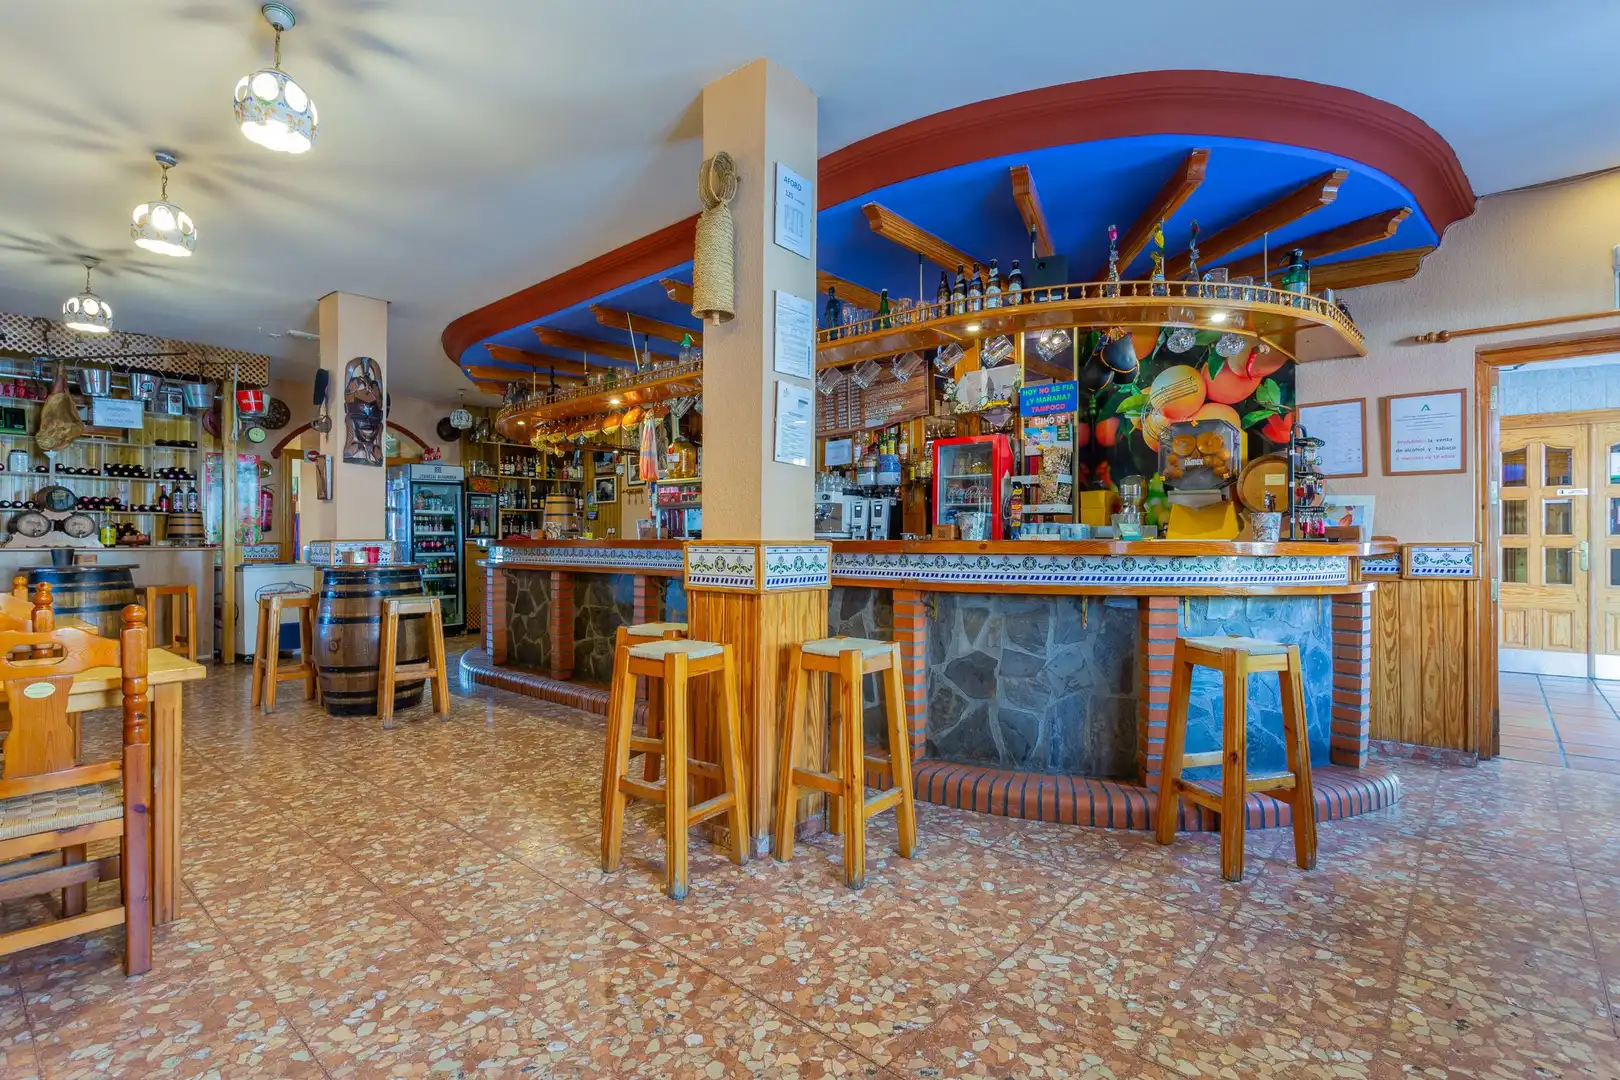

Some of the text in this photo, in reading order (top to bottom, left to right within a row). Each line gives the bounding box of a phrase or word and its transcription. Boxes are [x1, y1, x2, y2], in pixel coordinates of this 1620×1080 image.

[784, 175, 802, 191] AFORO
[785, 189, 794, 200] 125
[1022, 388, 1037, 397] HOY
[1038, 387, 1050, 395] NO
[1036, 394, 1071, 403] MAÑANA?
[1031, 403, 1066, 413] TAMPOCO
[1057, 415, 1066, 423] DE
